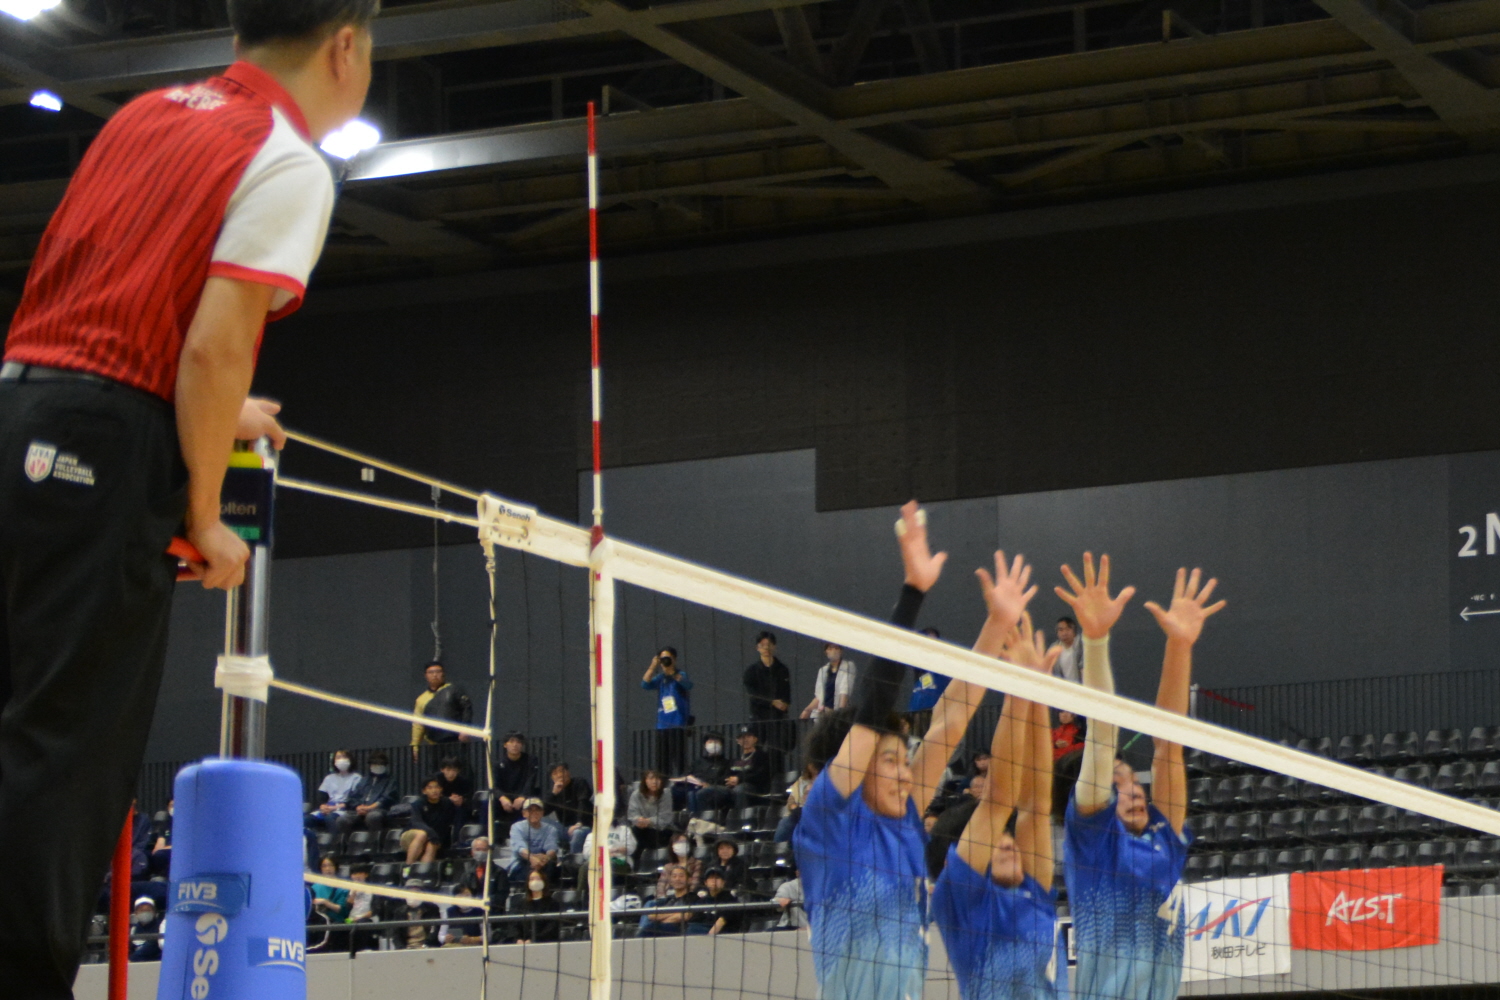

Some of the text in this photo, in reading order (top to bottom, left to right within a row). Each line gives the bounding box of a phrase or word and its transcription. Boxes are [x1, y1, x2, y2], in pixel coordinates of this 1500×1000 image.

[220, 502, 257, 515] olten
[1210, 942, 1267, 960] 秋田テレビ
